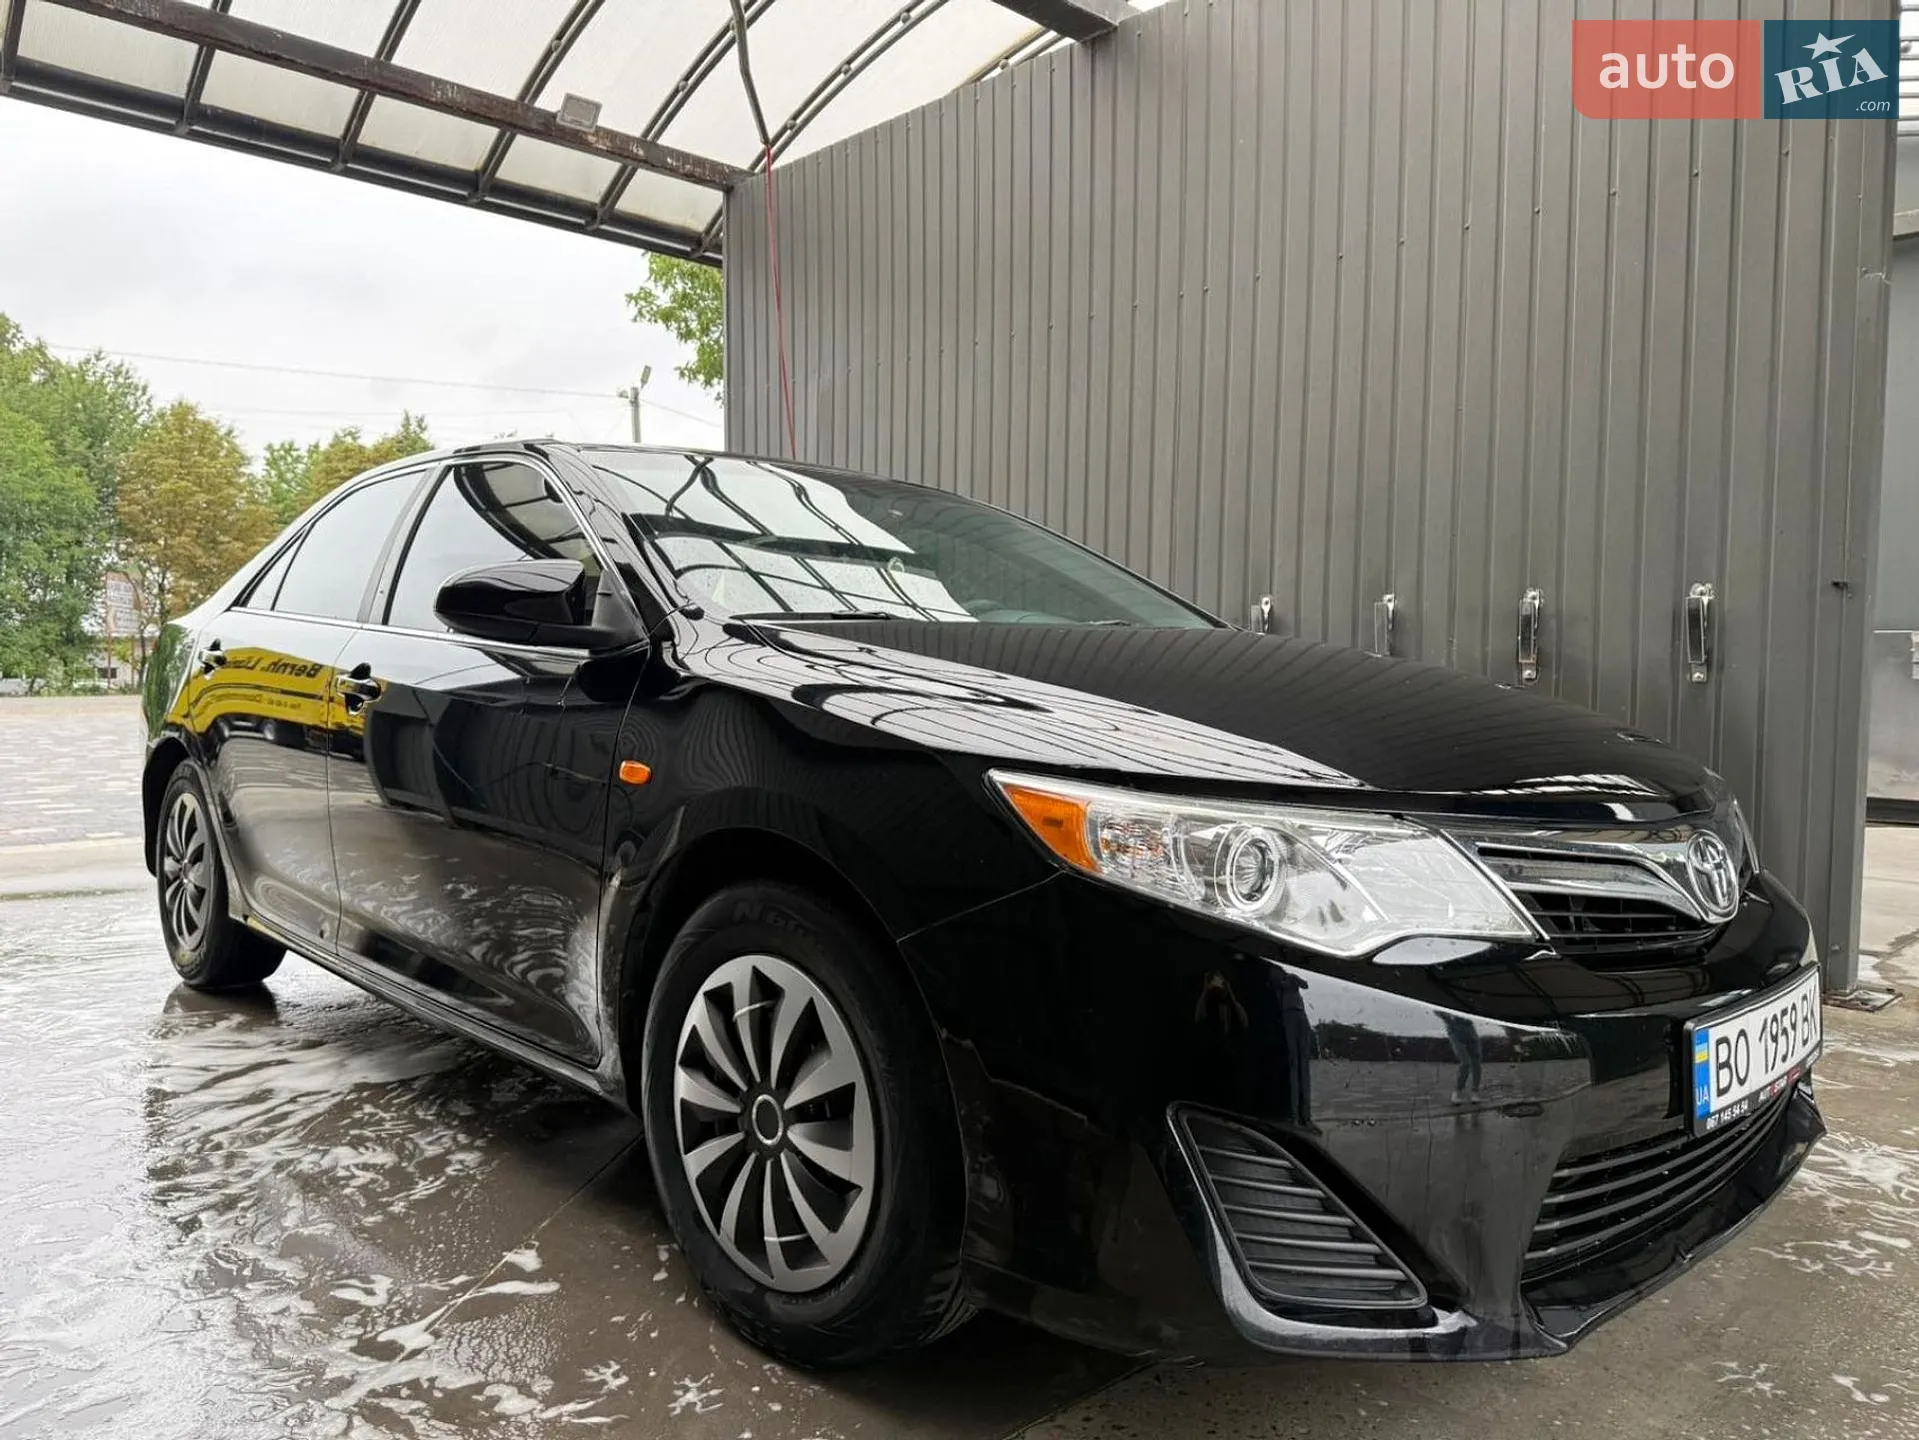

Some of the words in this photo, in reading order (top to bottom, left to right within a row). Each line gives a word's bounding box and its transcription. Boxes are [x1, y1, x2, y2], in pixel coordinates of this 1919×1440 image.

[1715, 1028, 1750, 1097] BO
[1758, 1002, 1797, 1074] 1959
[1802, 983, 1817, 1047] BK
[1696, 1086, 1710, 1107] UA
